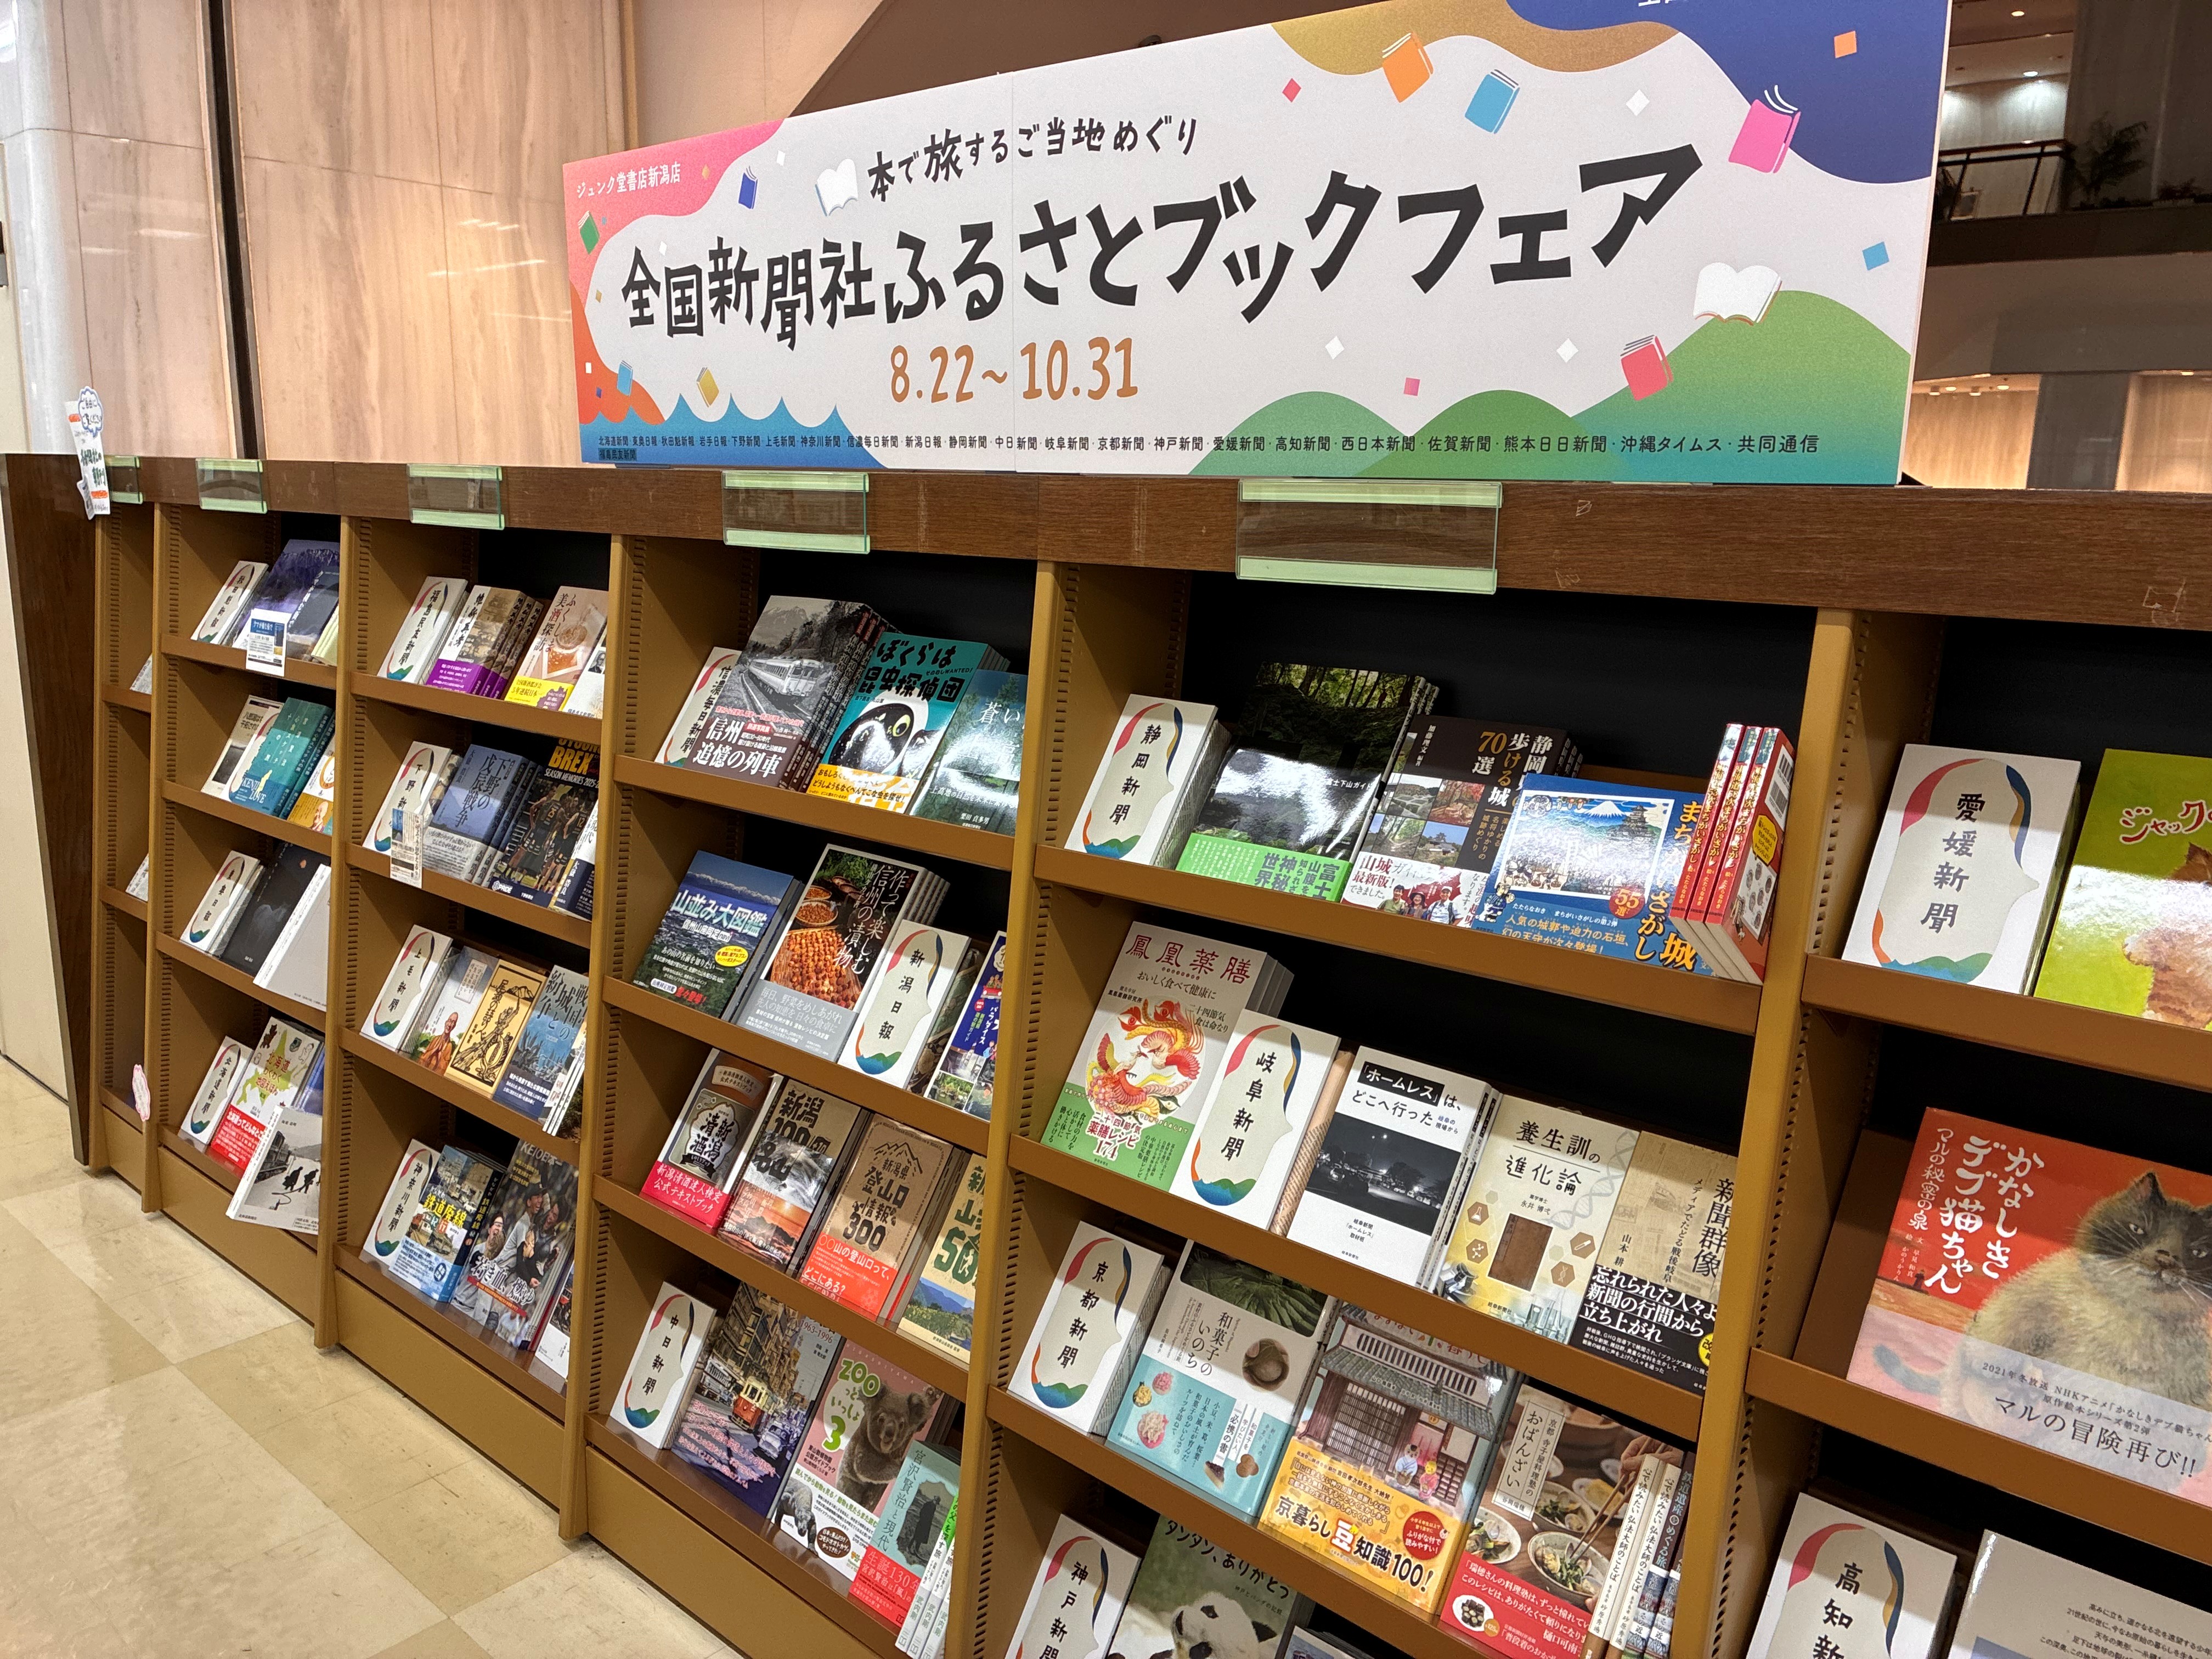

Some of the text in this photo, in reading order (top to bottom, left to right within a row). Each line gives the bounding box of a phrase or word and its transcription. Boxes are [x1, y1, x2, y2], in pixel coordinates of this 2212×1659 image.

[868, 116, 1195, 202] 本で旅するご当地めぐり
[576, 160, 681, 200] ジュンク堂書店新潟店
[620, 143, 1703, 352] 全国新聞社ふるさとブックフェア
[731, 436, 760, 447] 下野新聞
[800, 436, 841, 447] 神奈川新聞
[905, 436, 942, 448] 新潟日報
[949, 436, 988, 449] 静岡新聞
[995, 436, 1037, 450] 中日新聞
[1045, 436, 1089, 450] 岐阜新聞
[1098, 436, 1144, 451] 京都新聞
[1154, 436, 1203, 451] 神戸新聞
[1213, 436, 1265, 451] 愛媛新聞
[1275, 436, 1330, 452] 高知新聞
[1341, 436, 1415, 452] 西日本新聞
[1427, 436, 1491, 452] 佐賀新聞
[1503, 435, 1607, 453] 熊本日日新聞
[1621, 435, 1722, 453] 沖縄タイムス
[1737, 435, 1820, 453] 共同通信
[876, 638, 957, 669] ぼくらは
[858, 666, 966, 702] 昆虫探偵団
[706, 716, 746, 745] 信州
[548, 746, 594, 775] BREX
[692, 742, 783, 778] 追憶の列車
[1472, 731, 1507, 775] 70選
[1487, 732, 1530, 808] 歩ける城
[544, 768, 584, 785] SEASON MEMORIES
[1109, 724, 1162, 826] 静岡新聞
[1352, 871, 1394, 889] 最新版!
[1920, 792, 1986, 934] 愛媛新聞
[670, 889, 768, 938] 山並み大図鑑
[833, 865, 895, 969] 信州の漬物
[1614, 889, 1640, 906] 55
[851, 870, 910, 975] 作って楽しむ
[1126, 934, 1251, 984] 鳳凰薬膳
[1661, 932, 1698, 971] 城
[388, 949, 422, 1013] 上毛新聞
[878, 948, 925, 1040] 新潟日報
[1137, 971, 1217, 1001] おいしく食べて健康に
[1186, 1003, 1227, 1023] 二十四節気
[1194, 1015, 1228, 1034] 食は命なり
[266, 1051, 291, 1073] 北海道
[778, 1090, 825, 1129] 新潟
[1093, 1111, 1142, 1135] 二十四節気
[1221, 1051, 1277, 1163] 岐阜新聞
[1352, 1090, 1432, 1126] どこへ行った
[1437, 1114, 1455, 1126] 岐阜の
[1087, 1121, 1139, 1148] 薬膳レシピ
[1095, 1139, 1118, 1159] 174
[1435, 1122, 1459, 1135] 現場から
[1515, 1120, 1601, 1165] 養生訓の
[656, 1165, 724, 1204] 新潟清酒達人検定
[861, 1166, 910, 1209] 登山口
[881, 1158, 910, 1181] 新潟県
[1505, 1154, 1582, 1197] 進化論
[1908, 1127, 1955, 1232] マルの秘密の泉
[388, 1162, 423, 1232] 神奈川新聞
[422, 1193, 467, 1228] 鉄道廃線
[653, 1178, 714, 1214] 公式テキストブック
[860, 1199, 890, 1226] 情報
[1923, 1135, 2008, 1295] デブ猫ちゃん
[1980, 1146, 2045, 1280] かなしき
[843, 1210, 887, 1252] 300
[1692, 1178, 1735, 1279] 新聞群像
[803, 1266, 847, 1295] どこにある?
[1057, 1260, 1108, 1370] 京都新聞
[1579, 1301, 1663, 1343] 立ち上がれ
[1587, 1284, 1706, 1337] 新聞の行間から
[800, 1319, 834, 1344] 1963-1996
[1184, 1319, 1211, 1370] いのち
[1200, 1311, 1234, 1376] 和菓子の
[642, 1314, 679, 1396] 中日新聞
[840, 1358, 881, 1397] ZOO
[1982, 1361, 2050, 1392] 2021年冬放送
[831, 1395, 861, 1422] いっしょ
[2042, 1393, 2152, 1436] 原作絵本シリーズ第2弾
[822, 1414, 847, 1453] 3
[1219, 1415, 1239, 1454] 必携の書
[1505, 1410, 1544, 1489] おばんざい
[1993, 1395, 2197, 1478] マルの冒険再び!!
[1525, 1418, 1558, 1497] 京都 寺子屋料理塾の
[877, 1449, 927, 1553] 宮沢賢治と現代
[1609, 1466, 1654, 1583] 心で読みたい弘法大師のことば
